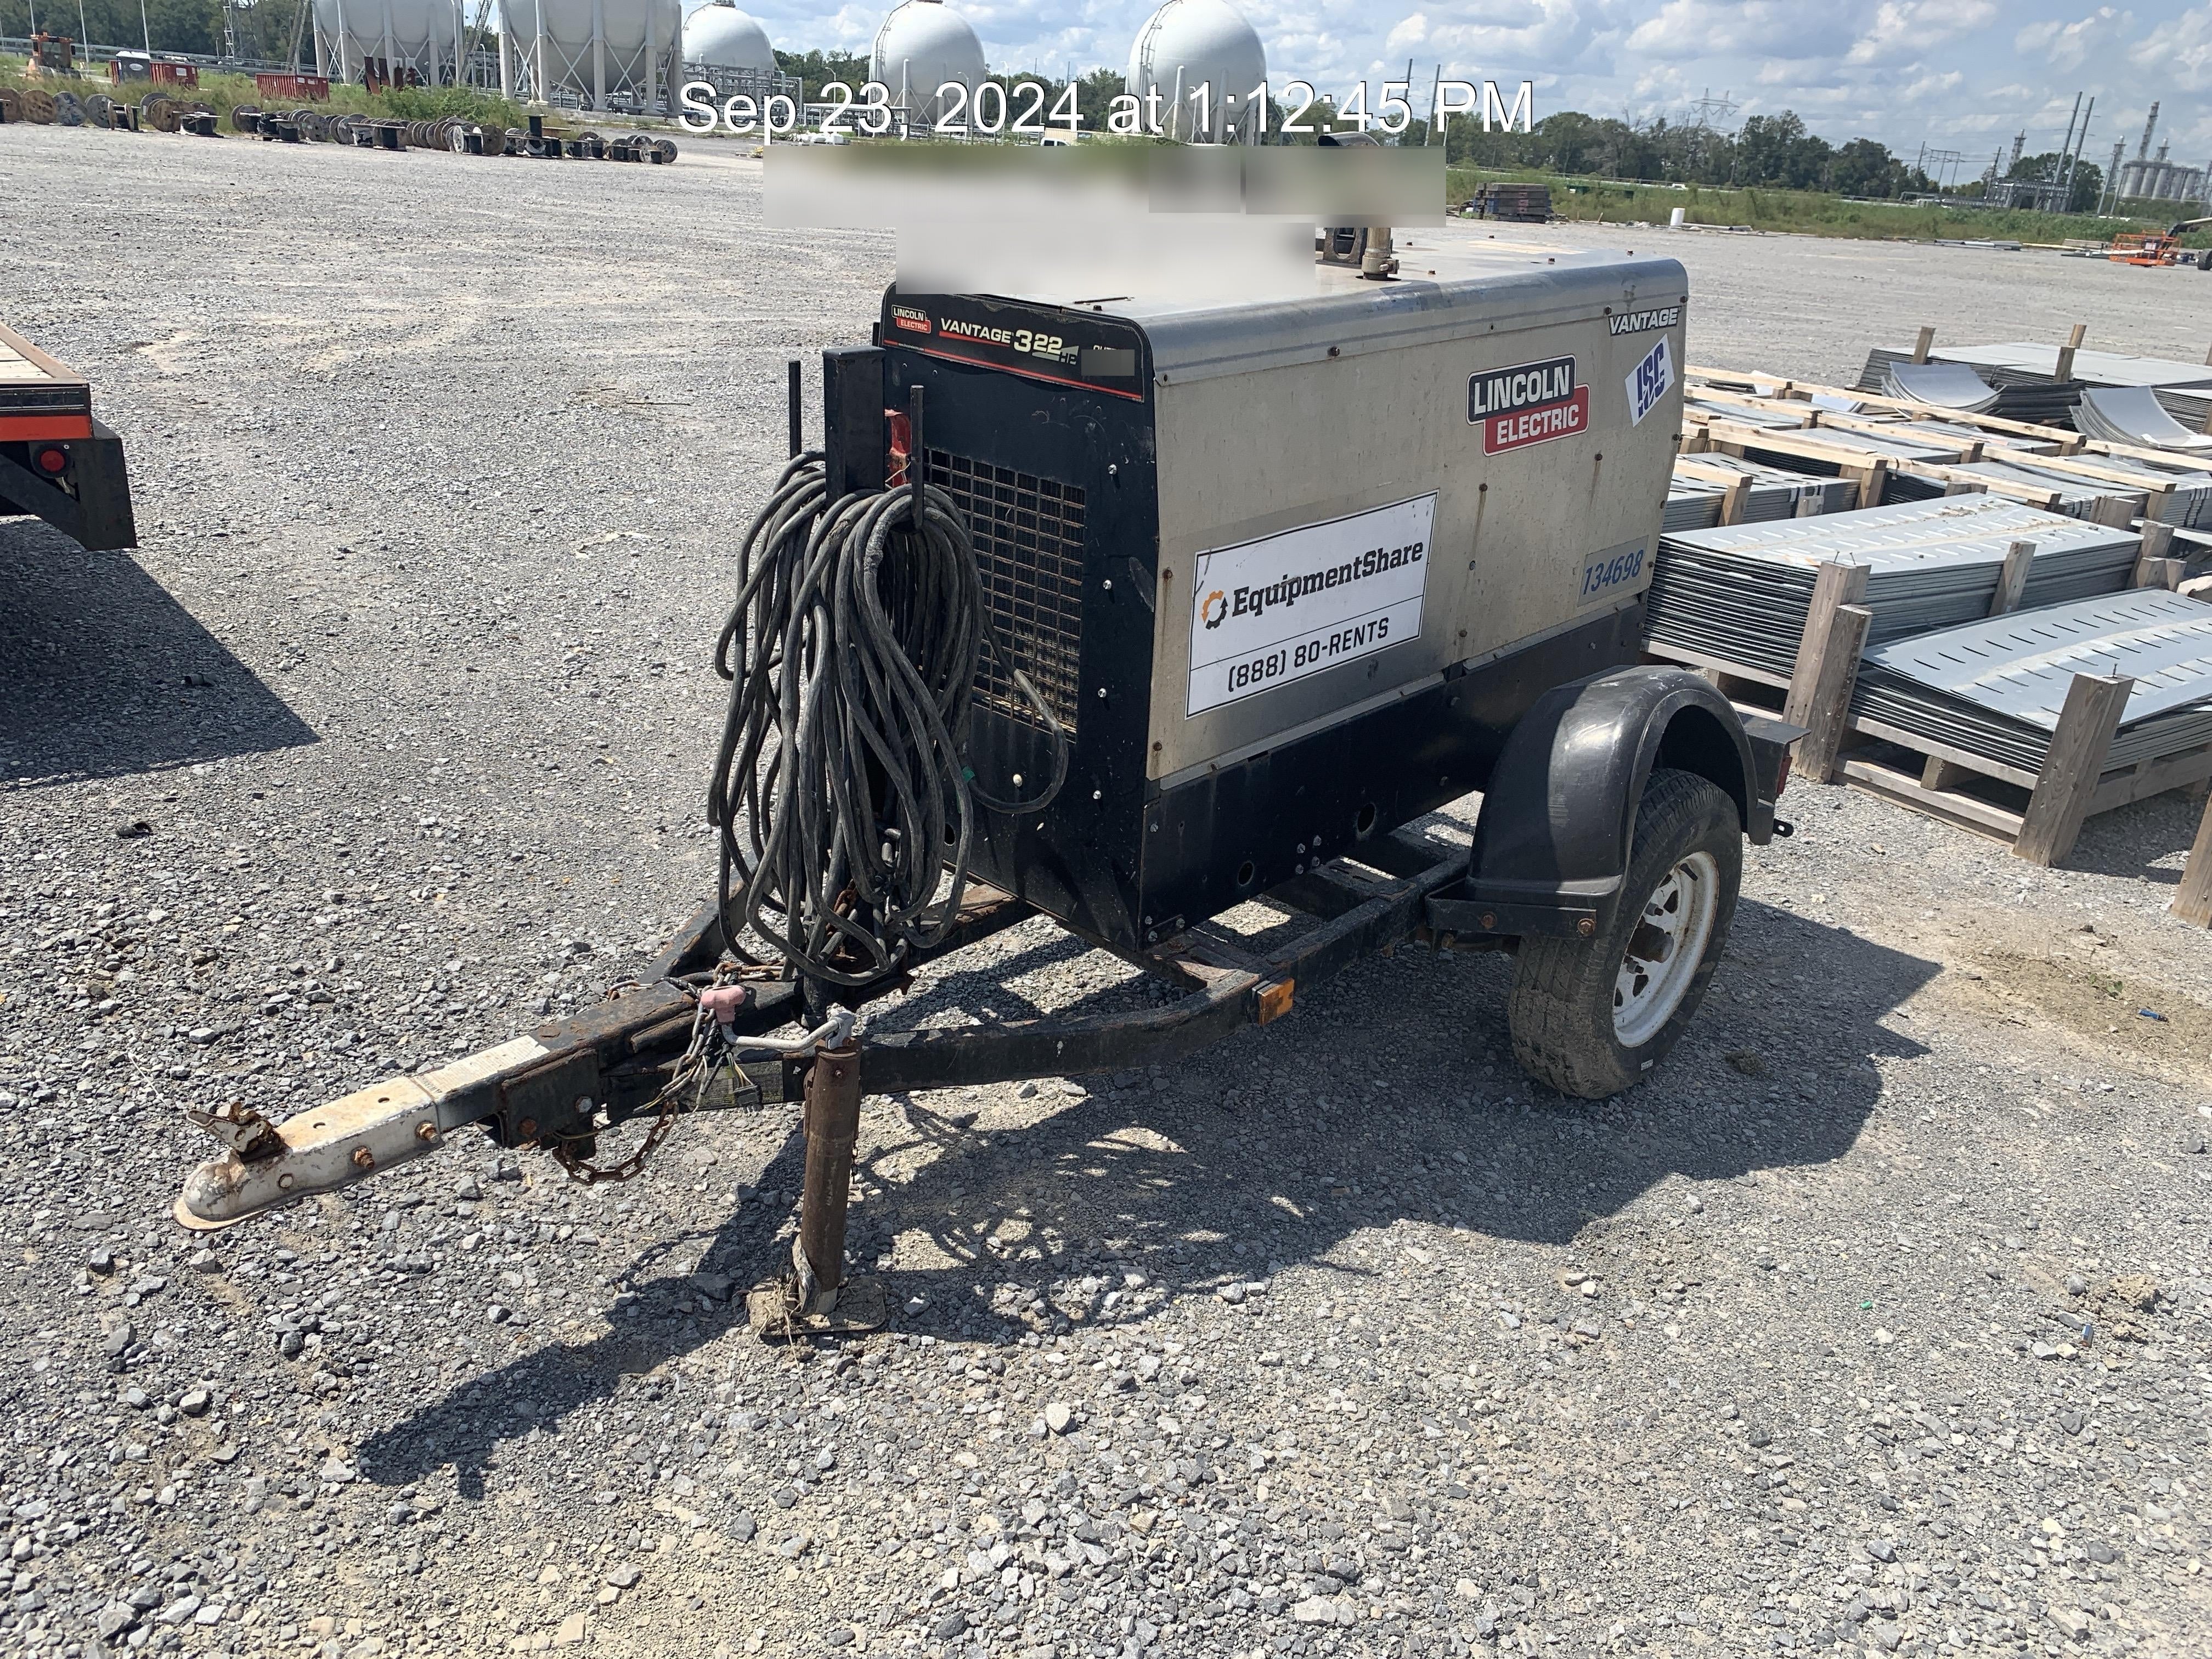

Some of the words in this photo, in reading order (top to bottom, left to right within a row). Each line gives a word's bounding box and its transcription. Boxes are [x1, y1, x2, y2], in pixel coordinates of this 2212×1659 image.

[893, 307, 924, 321] LINCOLN
[900, 319, 928, 331] ELECTRIC
[1609, 307, 1679, 335] VANTAGE
[940, 318, 1011, 344] VANTAGE
[1013, 329, 1063, 356] 322
[1474, 364, 1570, 415] LINCOLN
[1496, 404, 1579, 445] ELECTRIC
[1232, 541, 1424, 617] EquipmentShare
[1583, 549, 1644, 595] 134698
[1228, 650, 1286, 692] (888)
[1294, 617, 1390, 668] 80-RENTS
